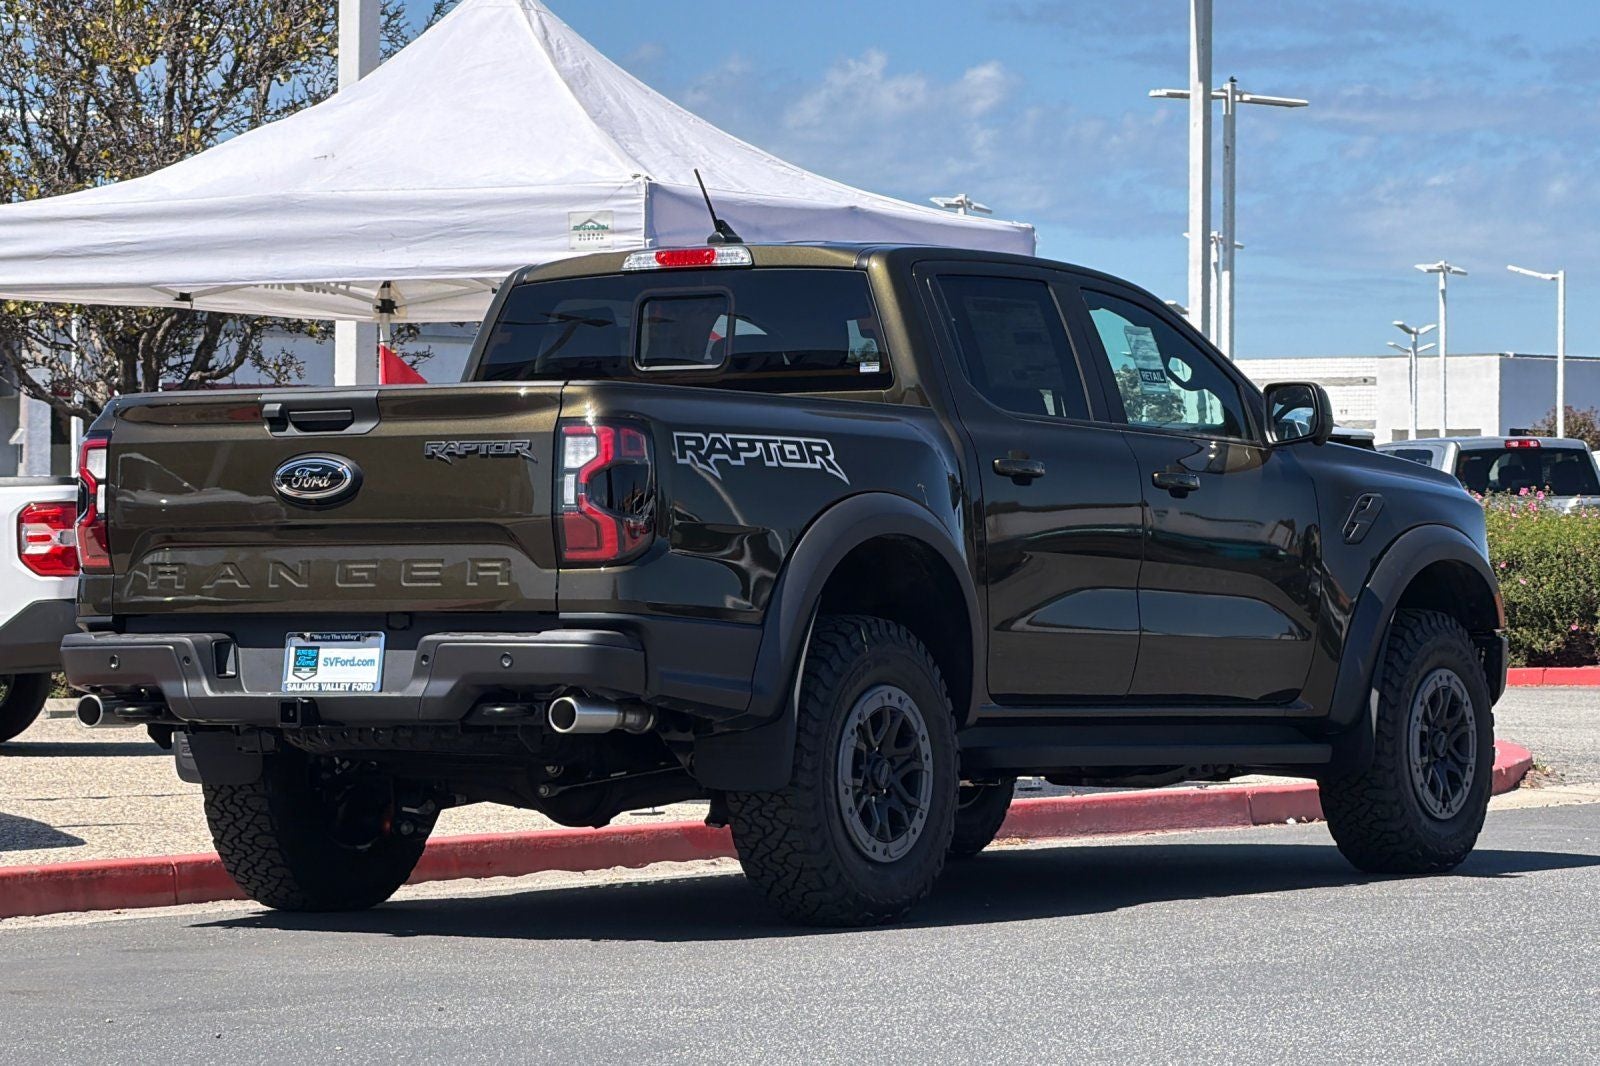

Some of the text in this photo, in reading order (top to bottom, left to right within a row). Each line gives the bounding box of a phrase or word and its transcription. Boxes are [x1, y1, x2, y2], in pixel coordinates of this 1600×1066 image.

[1140, 370, 1165, 381] RETAIL
[424, 439, 539, 465] RAPTOR
[672, 431, 851, 486] RAPTOR
[290, 466, 331, 489] Ford
[146, 557, 512, 589] RANGER
[322, 656, 375, 667] SVFord.com
[286, 682, 374, 692] SALINAS VALLEY FORD
